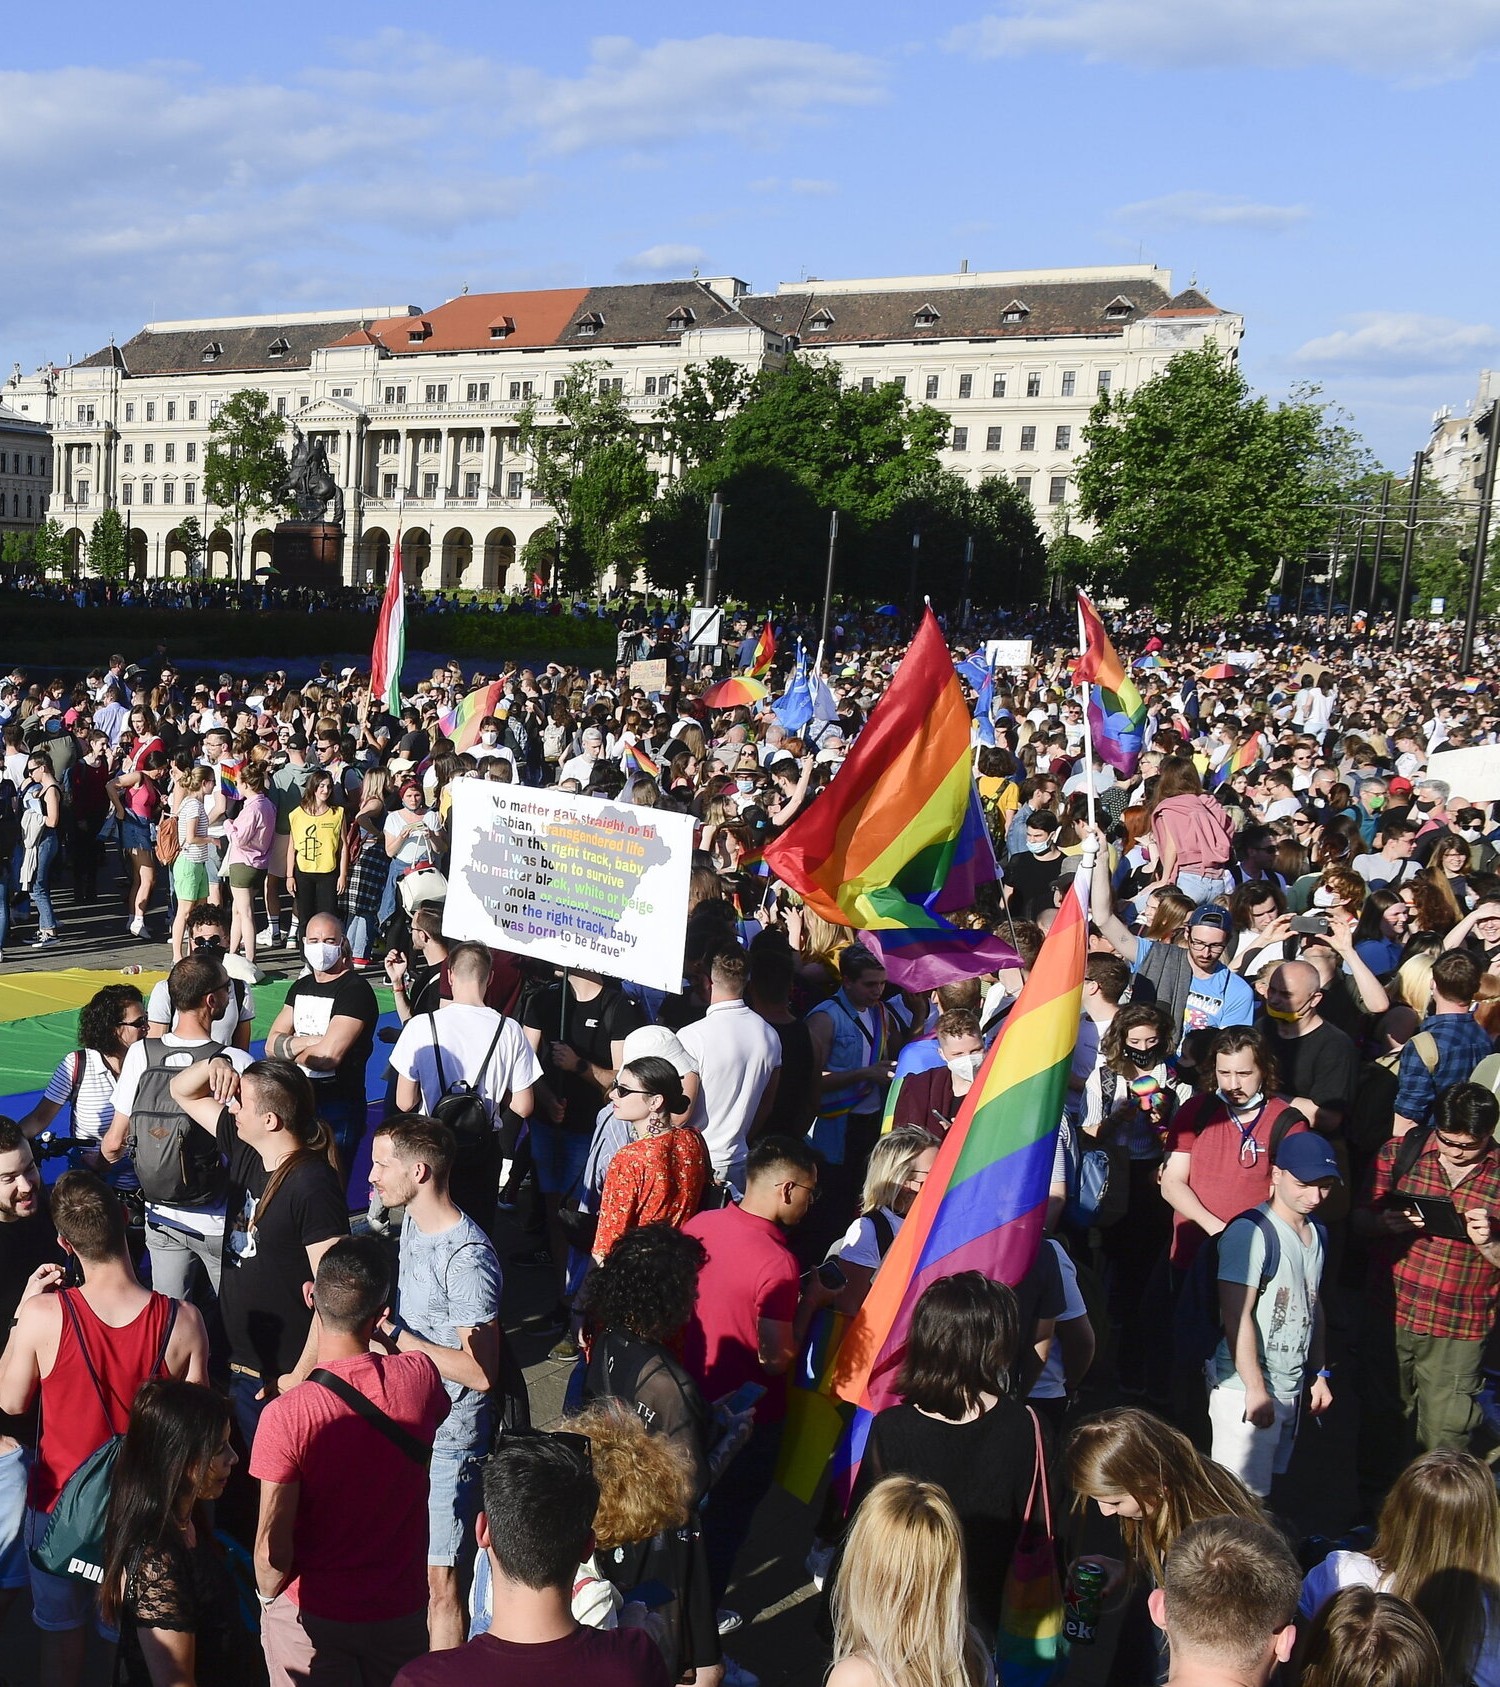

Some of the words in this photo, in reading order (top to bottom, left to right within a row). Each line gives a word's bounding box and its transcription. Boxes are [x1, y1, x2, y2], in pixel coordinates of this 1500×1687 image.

[510, 802, 549, 816] matter
[582, 814, 625, 834] straight
[628, 825, 640, 836] or
[643, 825, 655, 840] bi
[541, 822, 624, 852] transgendered
[627, 839, 645, 857] life
[488, 830, 504, 844] I'm
[509, 835, 523, 847] on
[528, 836, 548, 851] the
[551, 841, 580, 858] right
[582, 848, 612, 870] track,
[615, 856, 644, 878] baby
[504, 850, 508, 862] I
[512, 853, 536, 866] was
[541, 856, 568, 873] born
[572, 862, 584, 876] to
[586, 868, 624, 888] survive
[492, 866, 532, 882] matter
[536, 872, 570, 894] black,
[575, 883, 605, 900] white
[608, 893, 619, 904] or
[622, 895, 654, 914] beige
[540, 893, 552, 903] or
[484, 896, 500, 910] I'm
[504, 902, 518, 914] on
[522, 904, 543, 918] the
[546, 910, 574, 927] right
[576, 916, 608, 938] track,
[610, 926, 638, 948] baby
[494, 915, 498, 926] I
[501, 918, 524, 932] was
[528, 922, 556, 938] born
[560, 930, 572, 942] to
[575, 932, 588, 947] be
[590, 937, 626, 958] brave"
